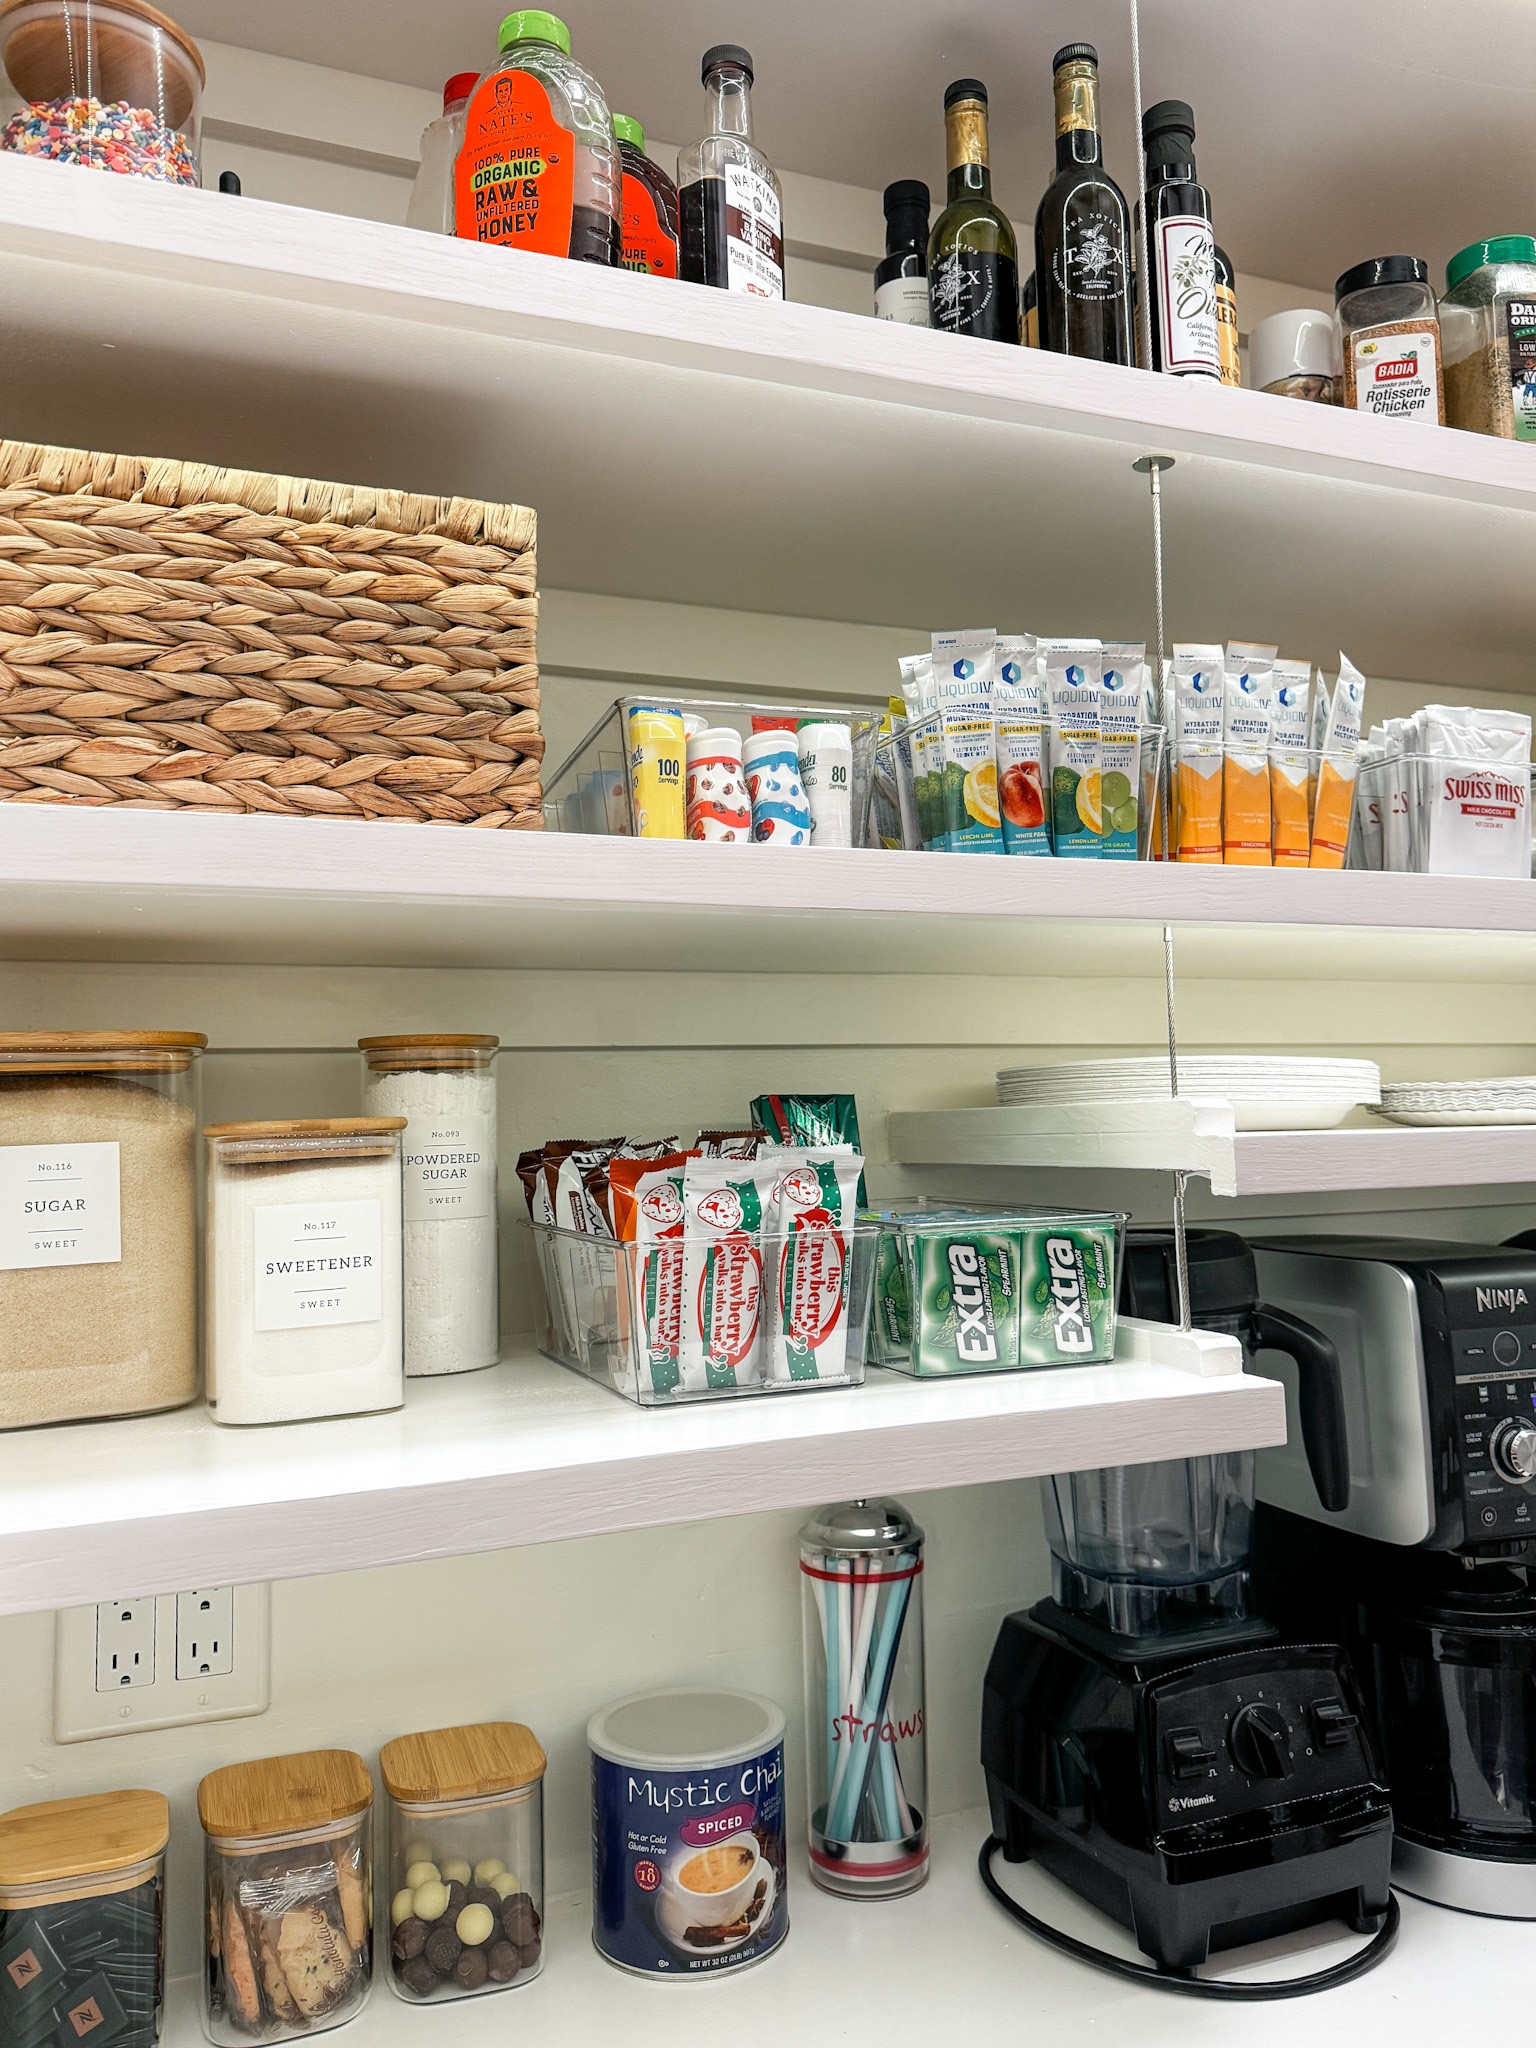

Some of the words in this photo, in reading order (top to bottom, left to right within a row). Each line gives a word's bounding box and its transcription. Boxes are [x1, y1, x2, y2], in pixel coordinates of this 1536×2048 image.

[478, 111, 534, 135] NATE'S
[473, 152, 505, 172] 100%
[509, 147, 541, 161] PURE
[474, 160, 541, 189] ORGANIC
[475, 181, 518, 212] RAW
[522, 178, 539, 198] &
[476, 199, 539, 222] UNFILTERED
[478, 212, 538, 242] HONEY
[1064, 216, 1084, 232] TEA
[1089, 212, 1121, 234] XOTICS
[1063, 246, 1078, 264] T
[1112, 246, 1124, 265] X
[966, 270, 981, 286] X
[1378, 362, 1415, 378] BADIA
[1366, 384, 1431, 403] Rotisserie
[1373, 399, 1425, 414] Chicken
[949, 722, 990, 732] SUGAR-FREE
[1186, 720, 1220, 728] HYDRATION
[1233, 719, 1268, 727] HYDRATION
[1063, 731, 1098, 739] SUGAR-FREE
[657, 758, 680, 777] 100
[831, 765, 846, 783] 80
[658, 776, 679, 785] Servings
[829, 783, 848, 791] Servings
[1443, 777, 1492, 801] SWISS
[1495, 782, 1525, 808] MISS
[1481, 807, 1512, 817] CHOCOLATE
[980, 832, 994, 840] LIME
[431, 1130, 461, 1138] No.093
[38, 1162, 73, 1172] No.116
[406, 1152, 481, 1166] POWDERED
[422, 1168, 468, 1180] SUGAR
[24, 1198, 87, 1214] SUGAR
[428, 1196, 463, 1205] SWEET
[303, 1221, 337, 1231] No.117
[34, 1239, 78, 1250] SWEET
[266, 1255, 373, 1275] SWEETENER
[716, 1253, 730, 1286] walks
[786, 1245, 794, 1285] CEREAL
[843, 1253, 851, 1282] TRADER
[978, 1255, 988, 1283] FLAVOR
[998, 1249, 1012, 1297] SPEARMINT
[1074, 1249, 1085, 1277] FLAVOR
[1094, 1242, 1106, 1289] SPEARMINT
[704, 1269, 713, 1306] CEREAL
[796, 1266, 807, 1291] into
[827, 1266, 841, 1293] this
[659, 1282, 670, 1305] into
[715, 1288, 727, 1312] into
[719, 1244, 750, 1356] strawberry
[746, 1285, 759, 1312] this
[796, 1293, 803, 1301] a
[842, 1283, 850, 1303] JOE'S
[981, 1282, 993, 1312] LASTING
[1045, 1238, 1094, 1353] Extra
[1078, 1275, 1089, 1305] LASTING
[1475, 1286, 1529, 1313] NINJA
[300, 1298, 341, 1309] SWEET
[948, 1244, 998, 1362] Extra
[1081, 1303, 1092, 1323] LONG
[702, 1313, 711, 1333] BAR
[715, 1314, 723, 1322] a
[884, 1296, 901, 1344] SPEARMINT
[985, 1311, 996, 1331] LONG
[1008, 1335, 1017, 1354] Sticks
[1103, 1328, 1112, 1346] Sticks
[831, 1703, 924, 1744] straws
[627, 1776, 732, 1814] Mystic
[739, 1750, 784, 1797] Chai
[1180, 1794, 1215, 1809] Vitamix
[697, 1815, 744, 1835] SPICED
[627, 1830, 640, 1841] Hot
[640, 1834, 649, 1842] or
[649, 1834, 668, 1845] Cold
[627, 1841, 650, 1854] Gluten
[650, 1844, 668, 1855] Free
[638, 1867, 656, 1883] 18
[318, 1925, 347, 1977] Honolulu
[690, 1960, 701, 1969] NET
[702, 1958, 711, 1967] WT
[711, 1957, 720, 1966] 32
[720, 1955, 728, 1964] OZ
